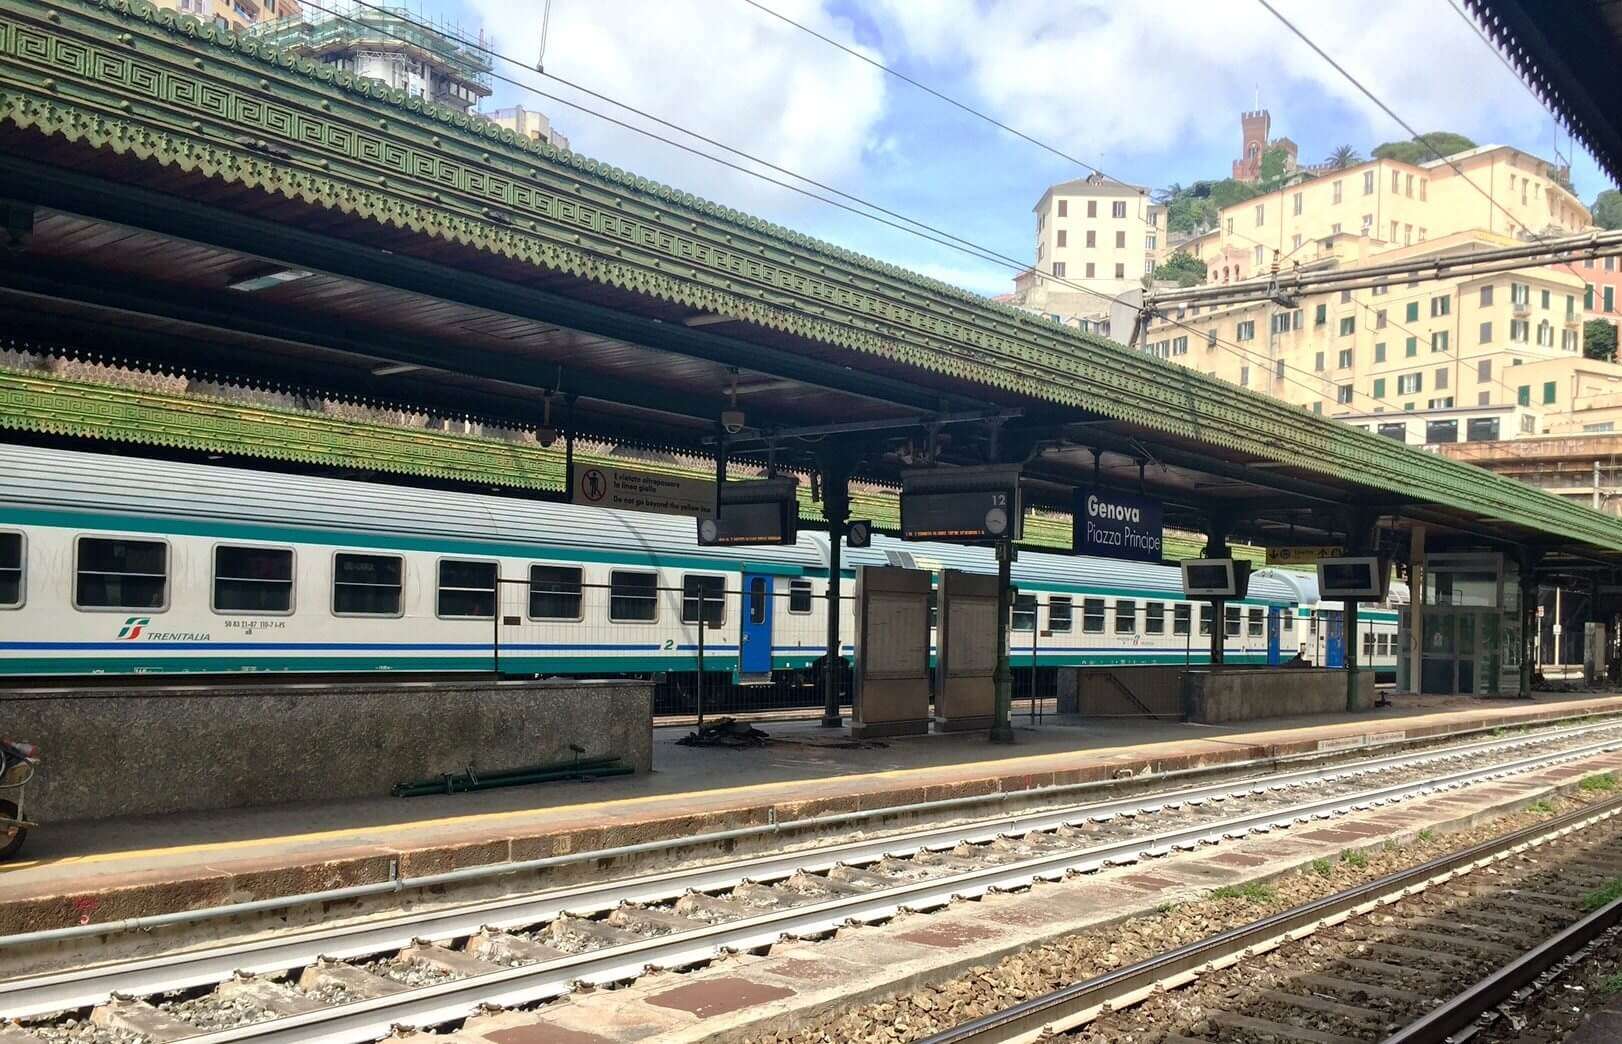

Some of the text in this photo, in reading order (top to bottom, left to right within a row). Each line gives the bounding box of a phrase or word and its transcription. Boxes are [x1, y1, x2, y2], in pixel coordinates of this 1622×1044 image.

[992, 495, 1007, 506] 12
[1087, 495, 1140, 522] Genova
[1087, 521, 1161, 554] Piazza Principe
[146, 632, 211, 641] TRENITALIA
[664, 639, 674, 650] 2
